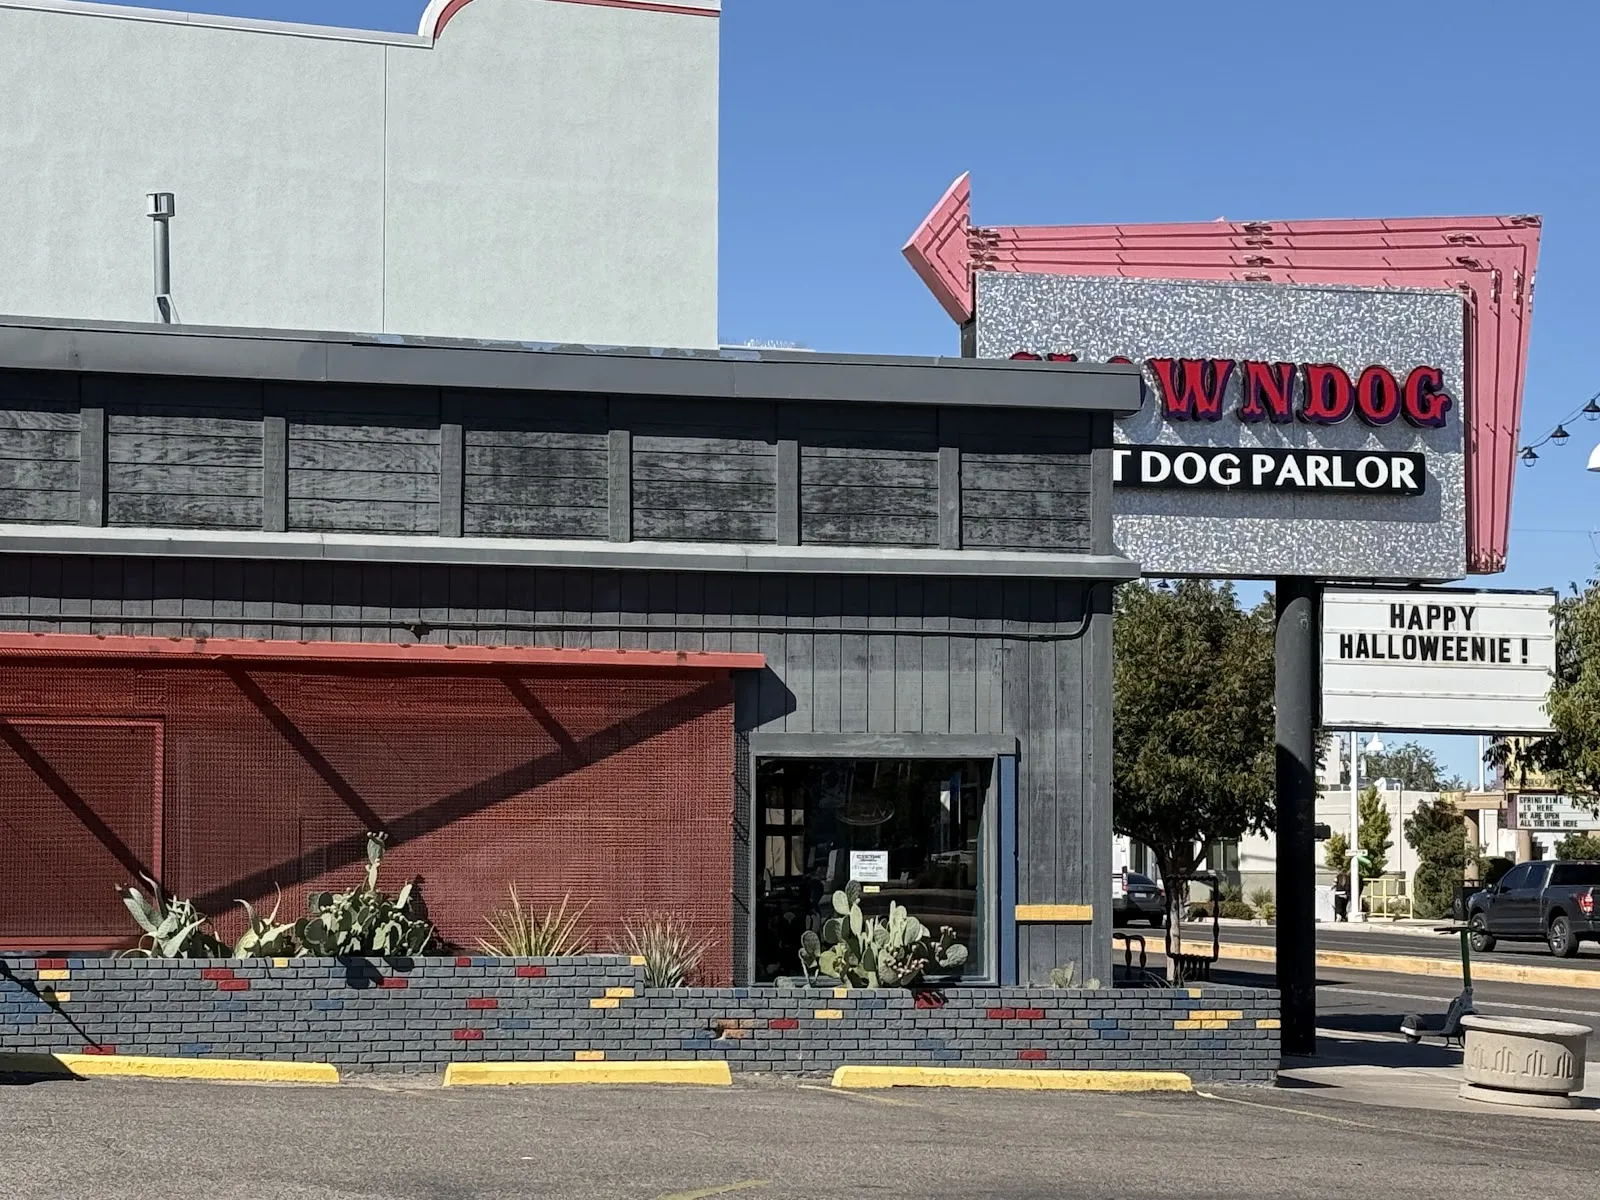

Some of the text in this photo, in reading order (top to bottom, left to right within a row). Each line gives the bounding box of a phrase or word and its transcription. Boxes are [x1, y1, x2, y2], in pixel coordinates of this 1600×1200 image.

[1009, 352, 1452, 428] WNDOG
[1141, 451, 1241, 486] DOG
[1253, 453, 1418, 489] PARLOR
[1390, 603, 1476, 631] HAPPY
